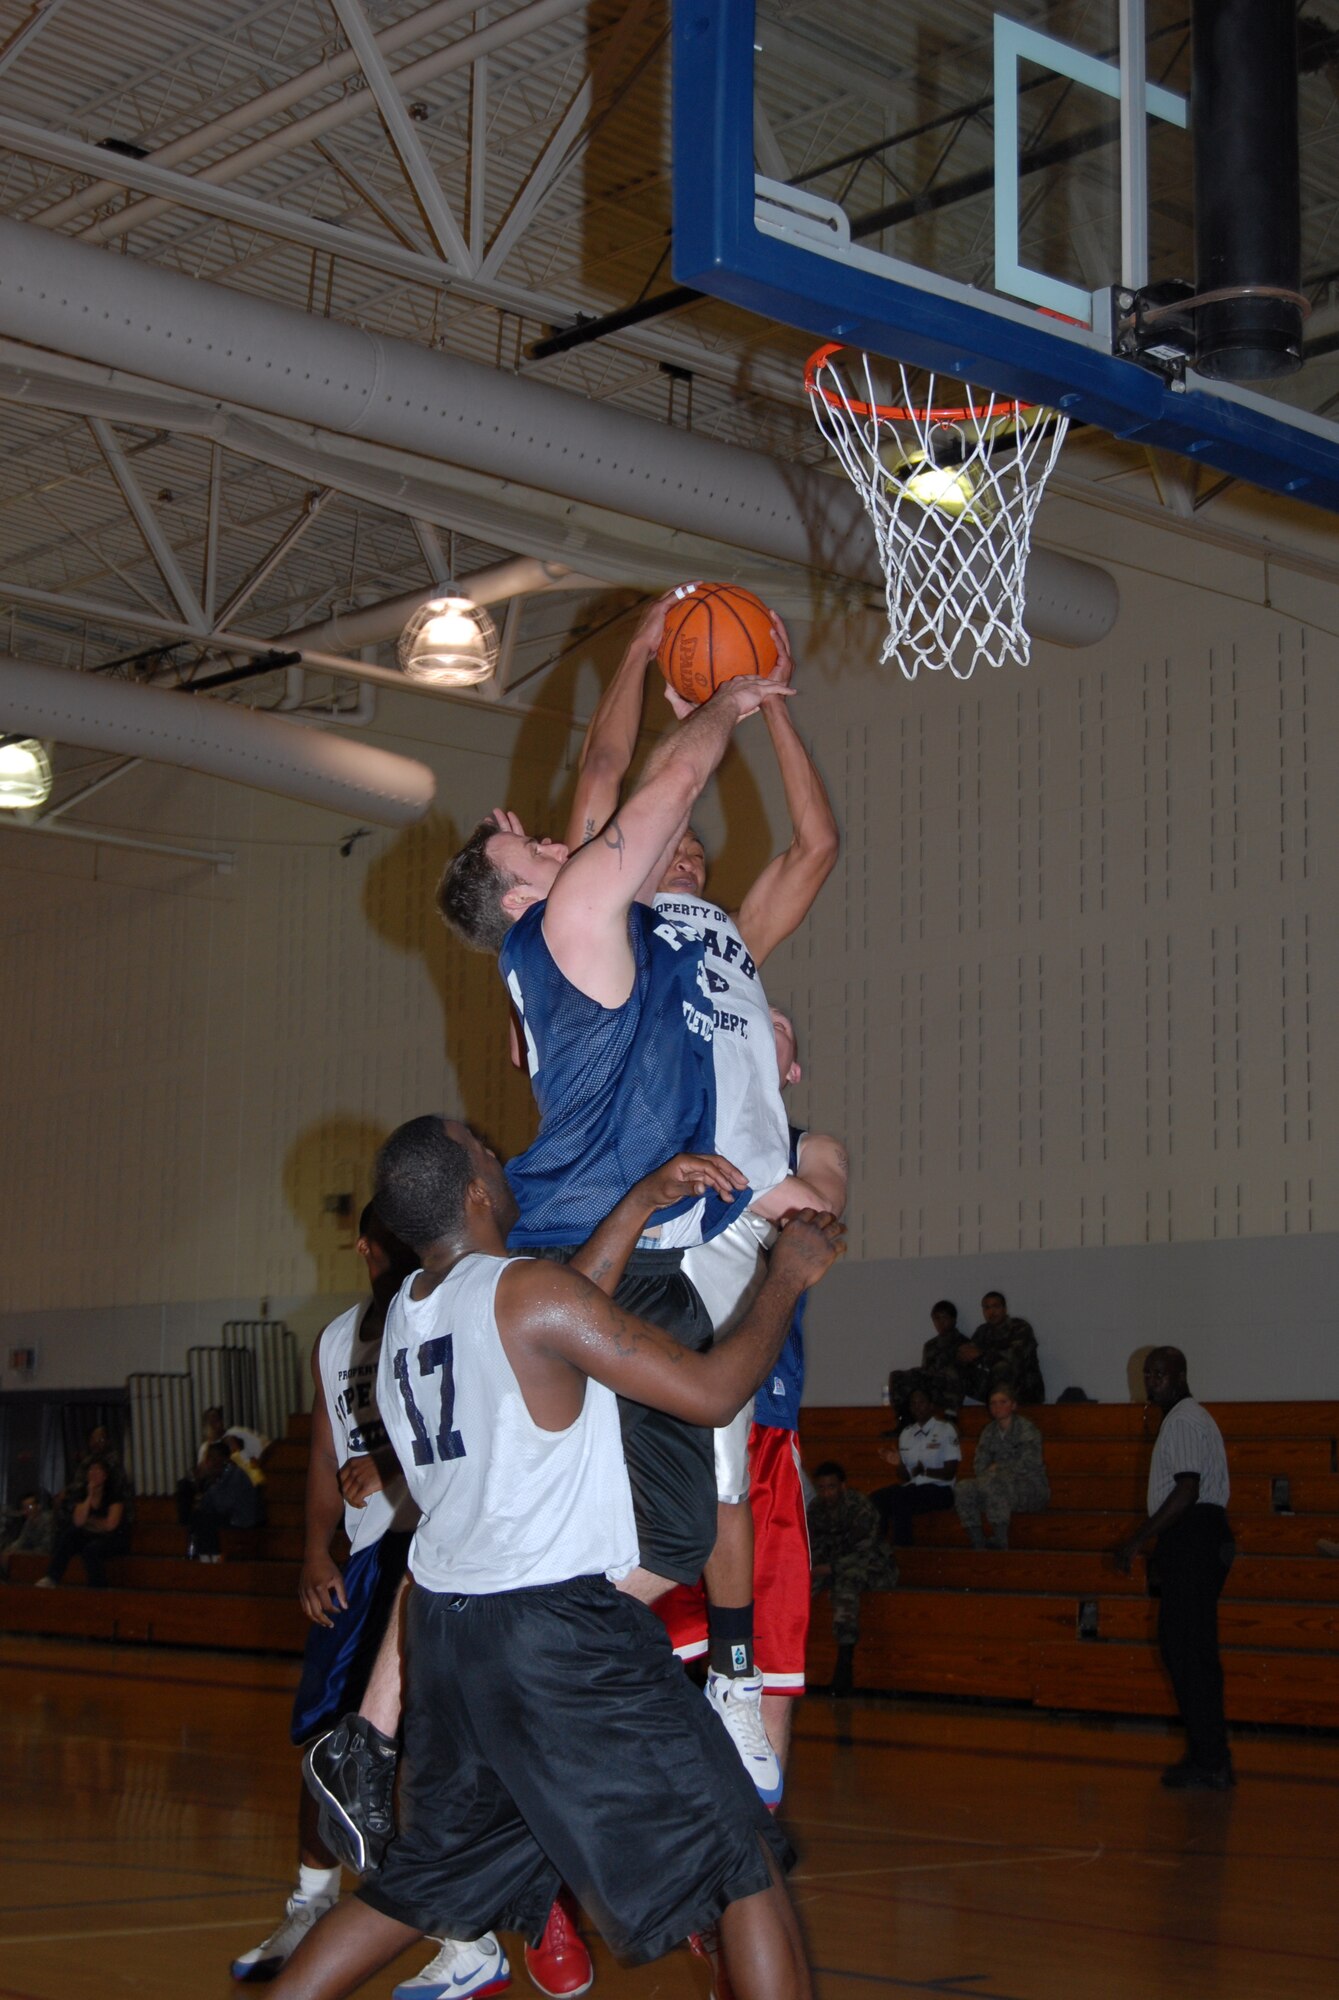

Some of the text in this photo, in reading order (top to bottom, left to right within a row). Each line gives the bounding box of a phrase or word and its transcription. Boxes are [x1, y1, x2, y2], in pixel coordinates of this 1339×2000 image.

[653, 902, 710, 919] OPERTY
[702, 927, 756, 980] AFB
[338, 1363, 379, 1381] PROPERT
[393, 1333, 467, 1466] 17
